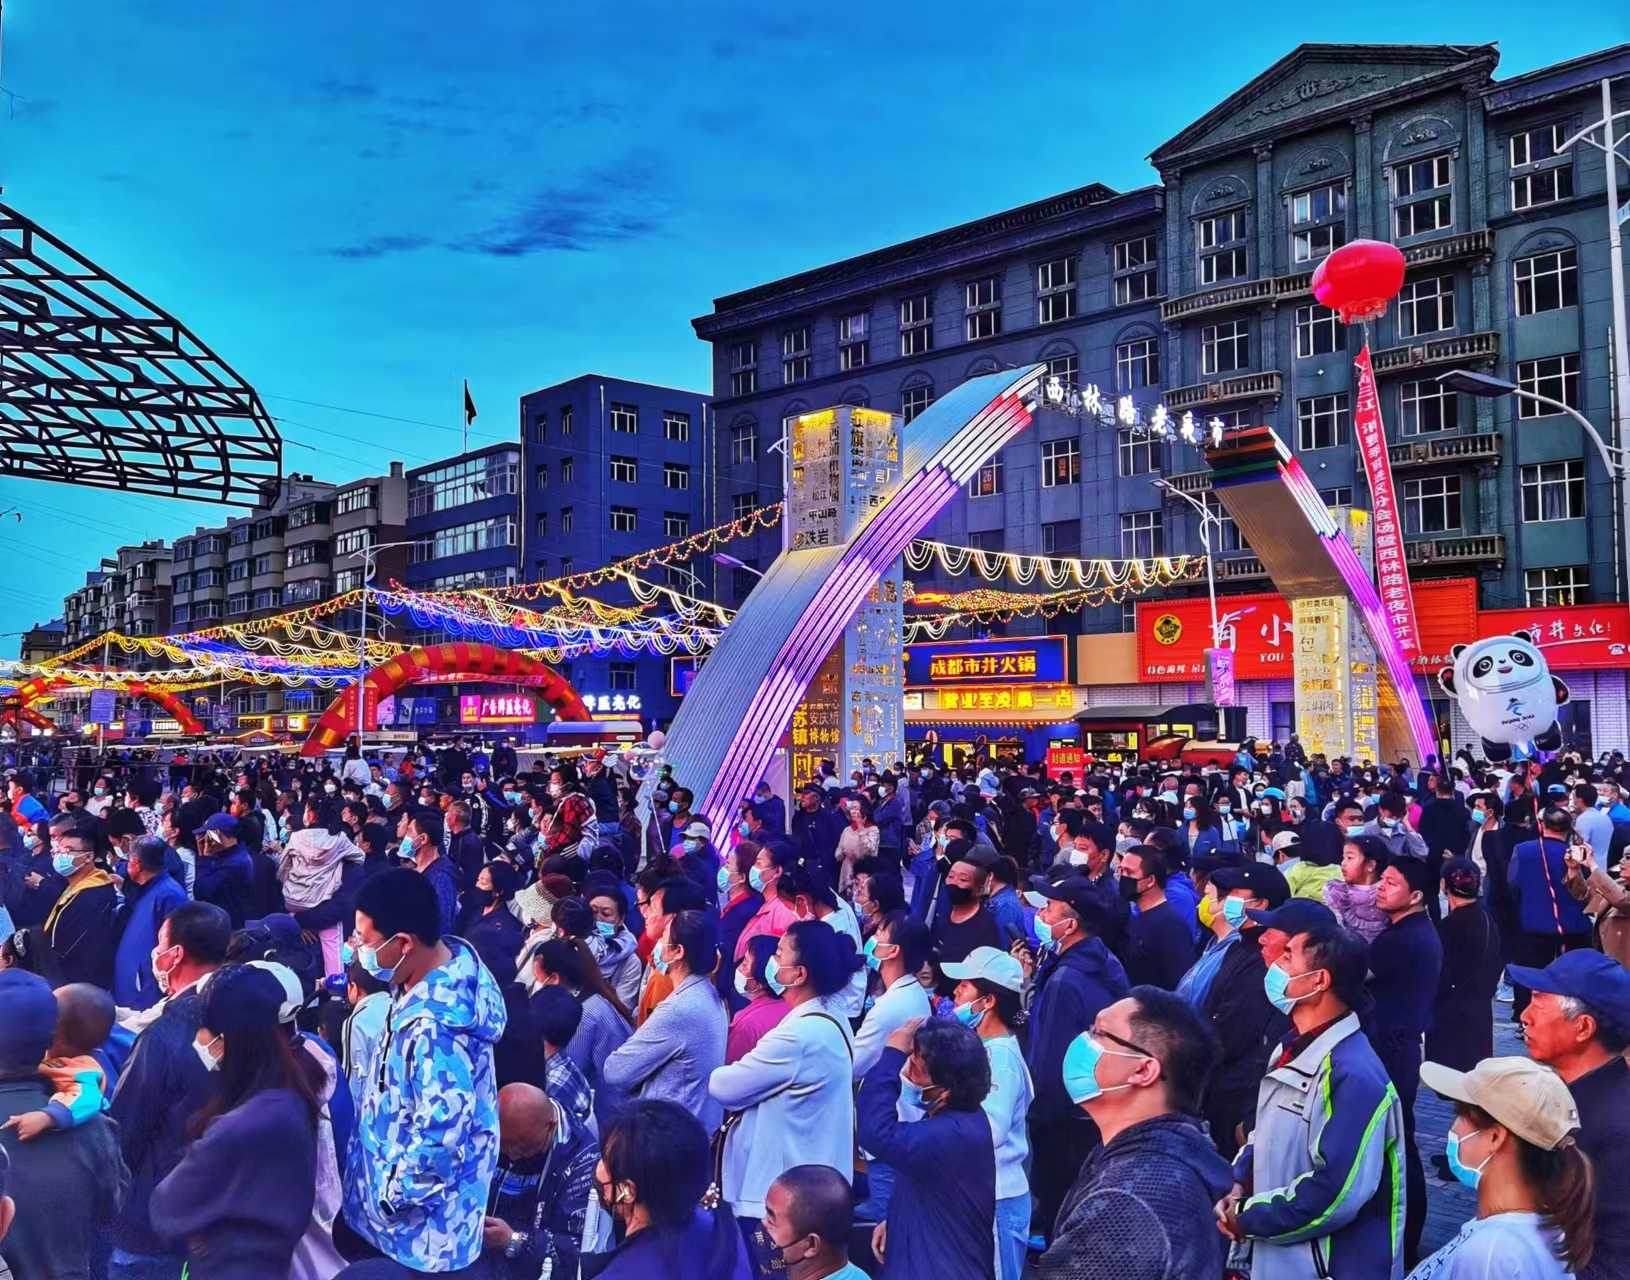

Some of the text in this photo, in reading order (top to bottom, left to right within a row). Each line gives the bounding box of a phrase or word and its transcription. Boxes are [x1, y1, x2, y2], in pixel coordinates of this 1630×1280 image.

[930, 655, 1037, 676] 成都市井火锅
[1260, 652, 1284, 663] YOU
[943, 690, 1073, 710] 营业至凌晨一点
